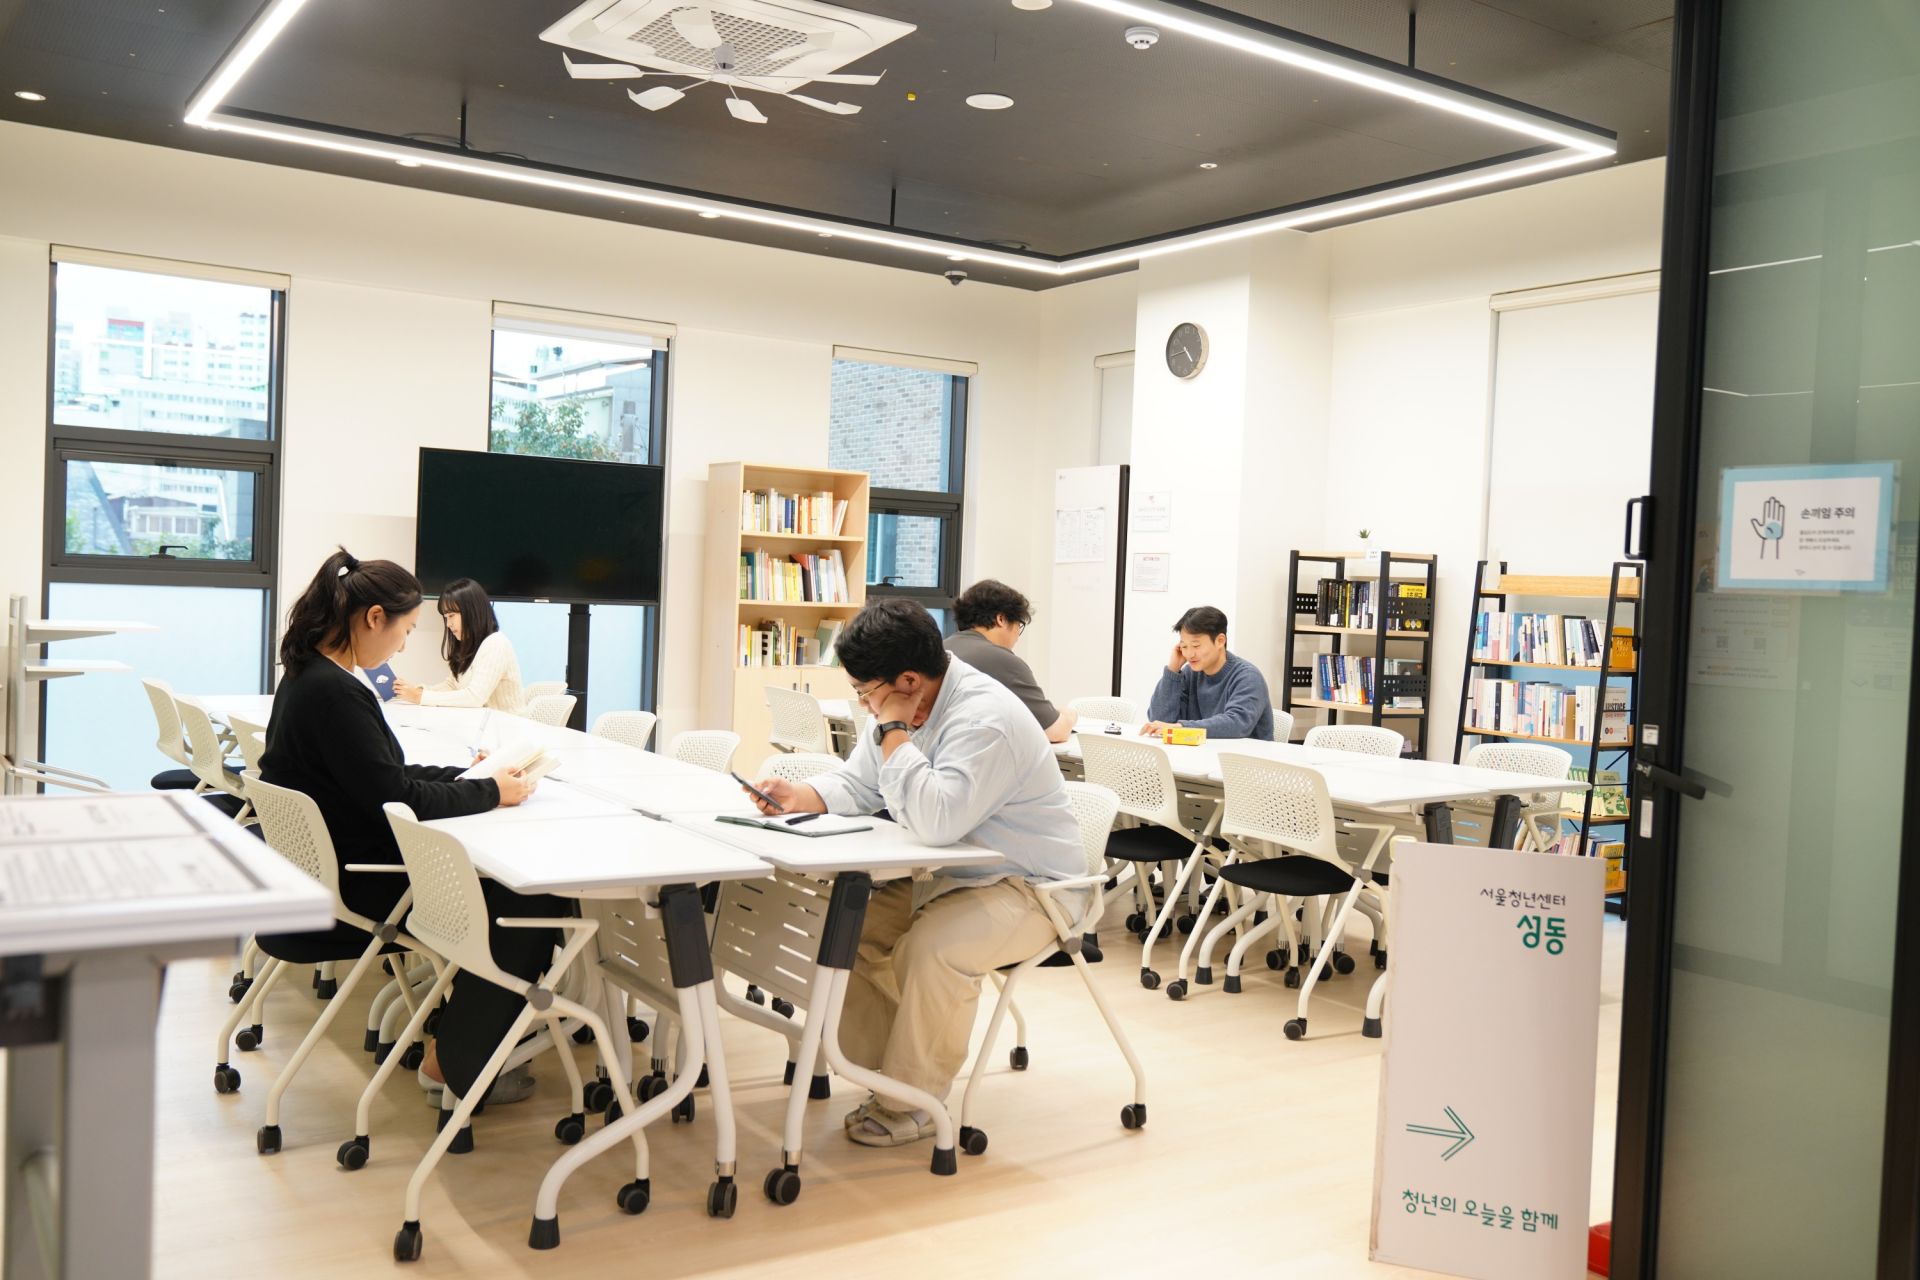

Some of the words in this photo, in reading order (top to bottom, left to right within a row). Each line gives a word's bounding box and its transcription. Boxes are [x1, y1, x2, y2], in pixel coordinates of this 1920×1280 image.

[1834, 506, 1856, 519] 주의
[1480, 888, 1566, 910] 서울청년센터
[1516, 914, 1567, 956] 성동
[1402, 1189, 1457, 1216] 청년의
[1462, 1200, 1515, 1230] 오늘을
[1520, 1208, 1559, 1233] 함께
